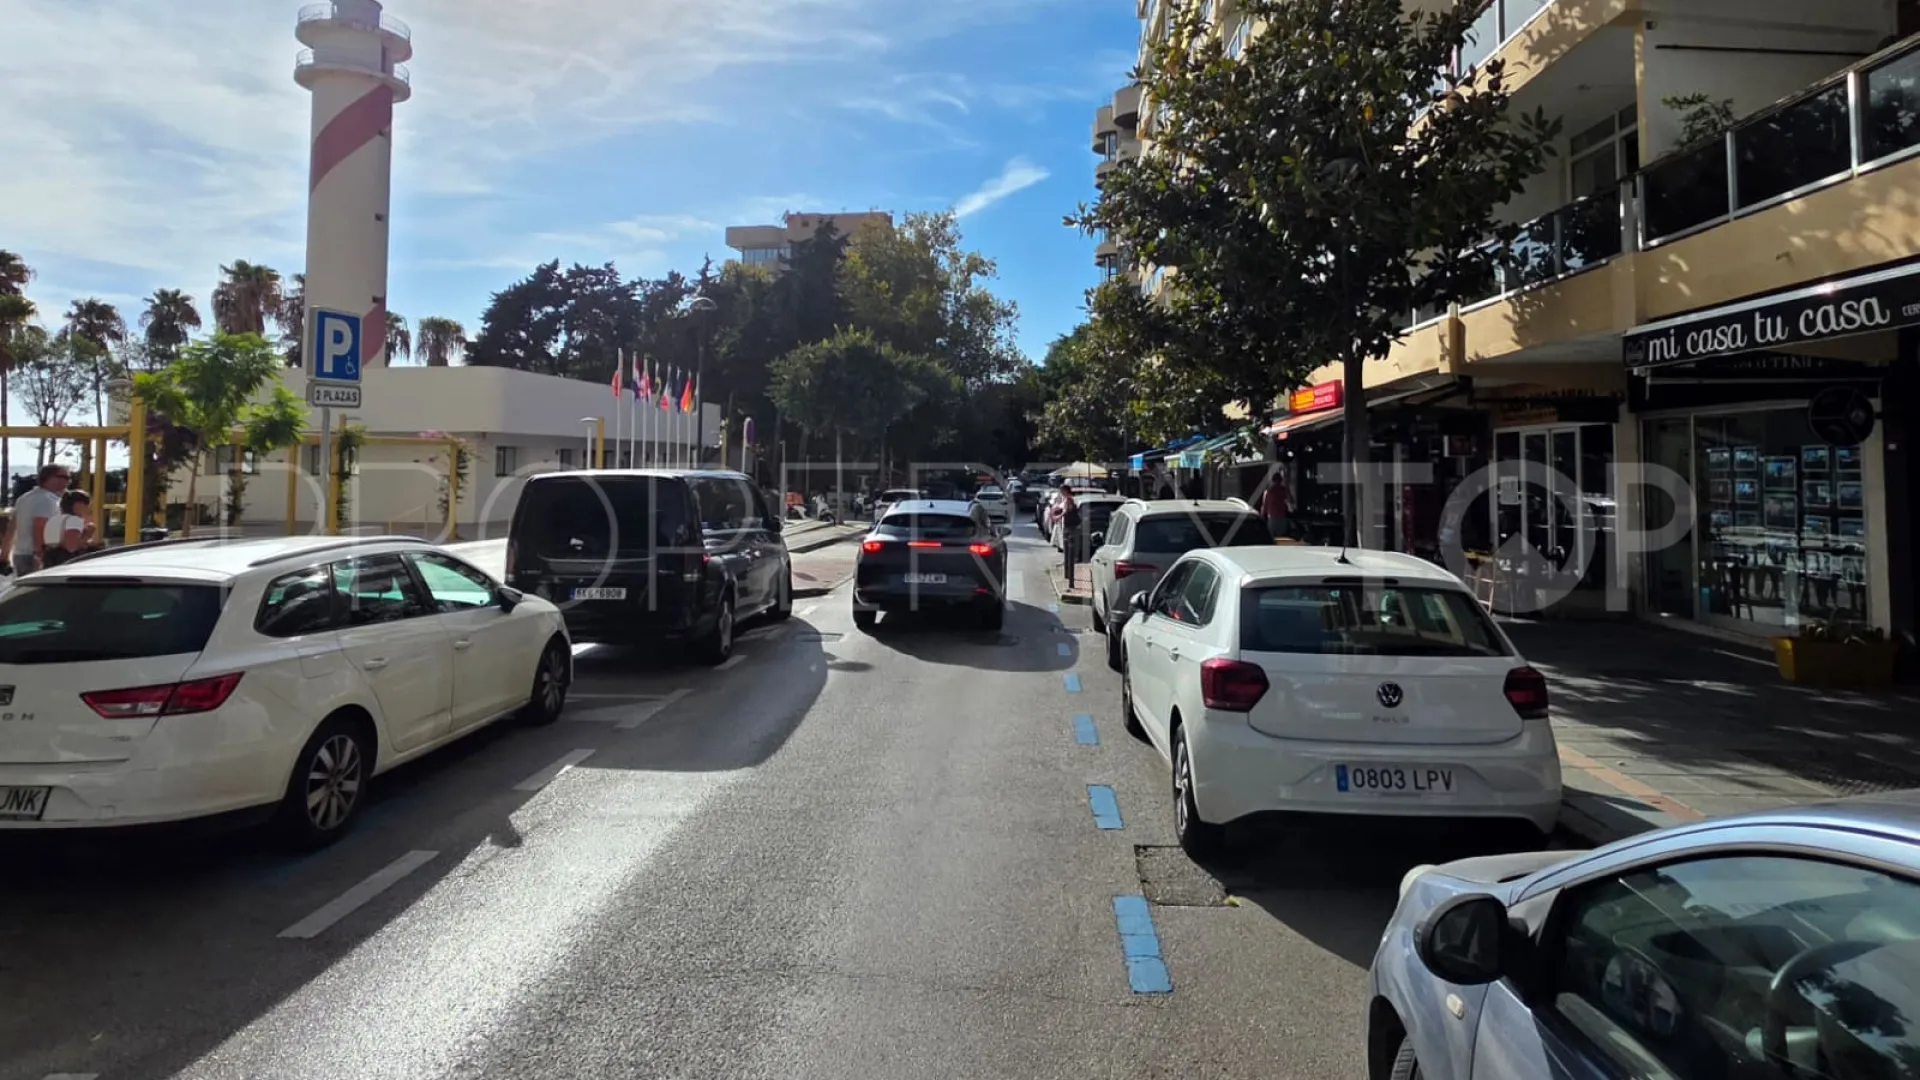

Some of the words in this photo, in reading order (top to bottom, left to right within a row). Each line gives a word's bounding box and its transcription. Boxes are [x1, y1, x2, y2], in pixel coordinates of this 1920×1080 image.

[323, 317, 352, 373] P
[1649, 328, 1680, 362] mi
[1686, 323, 1747, 355] casa
[1754, 311, 1788, 344] tu
[1799, 297, 1890, 337] casa
[323, 389, 357, 402] PLAZAS
[1353, 767, 1406, 790] 0803
[1413, 769, 1453, 792] LPV
